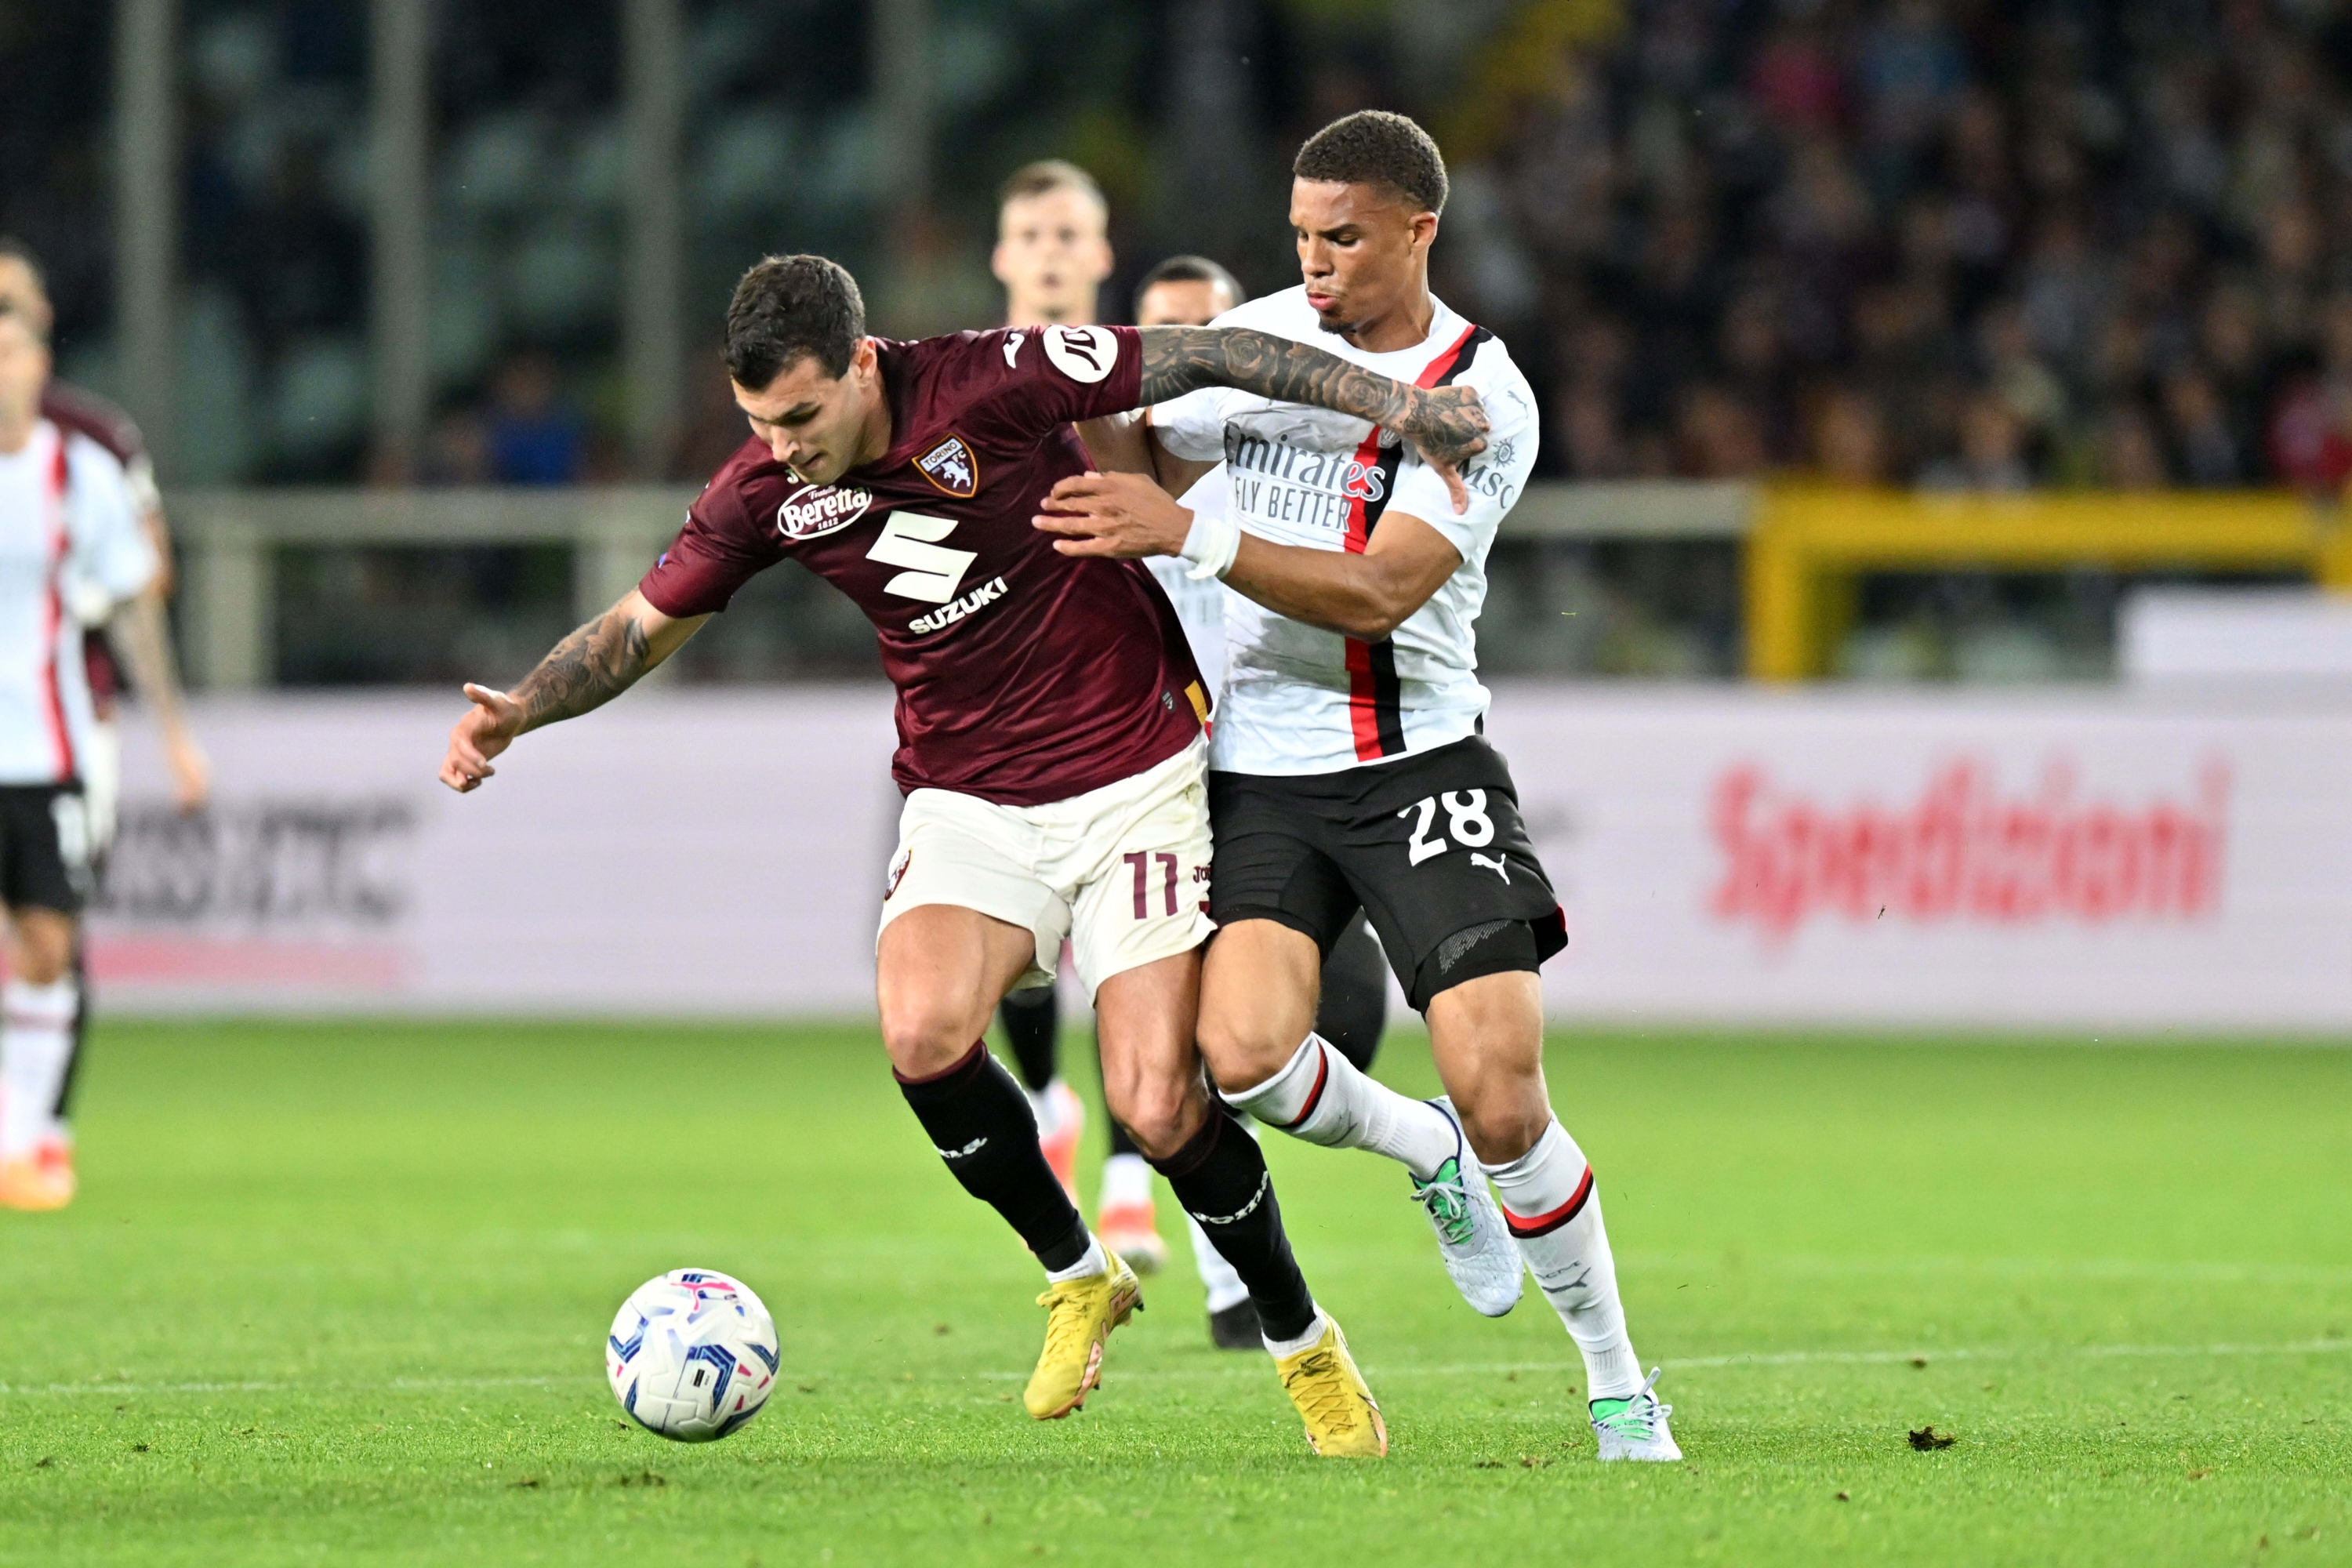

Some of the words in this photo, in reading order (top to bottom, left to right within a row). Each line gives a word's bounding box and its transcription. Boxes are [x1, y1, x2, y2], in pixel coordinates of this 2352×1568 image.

[924, 442, 957, 466] TORINO
[952, 450, 967, 463] FC
[1225, 421, 1385, 502] Emirates
[1235, 477, 1261, 514] FLY
[1268, 485, 1352, 532] BETTER
[1456, 456, 1515, 510] MSC
[782, 488, 868, 534] Beretta
[818, 517, 839, 531] 1812
[909, 576, 1009, 634] SUZUKI
[1397, 788, 1494, 867] 28
[1712, 757, 2230, 950] Spedizioni
[1123, 851, 1178, 920] 11
